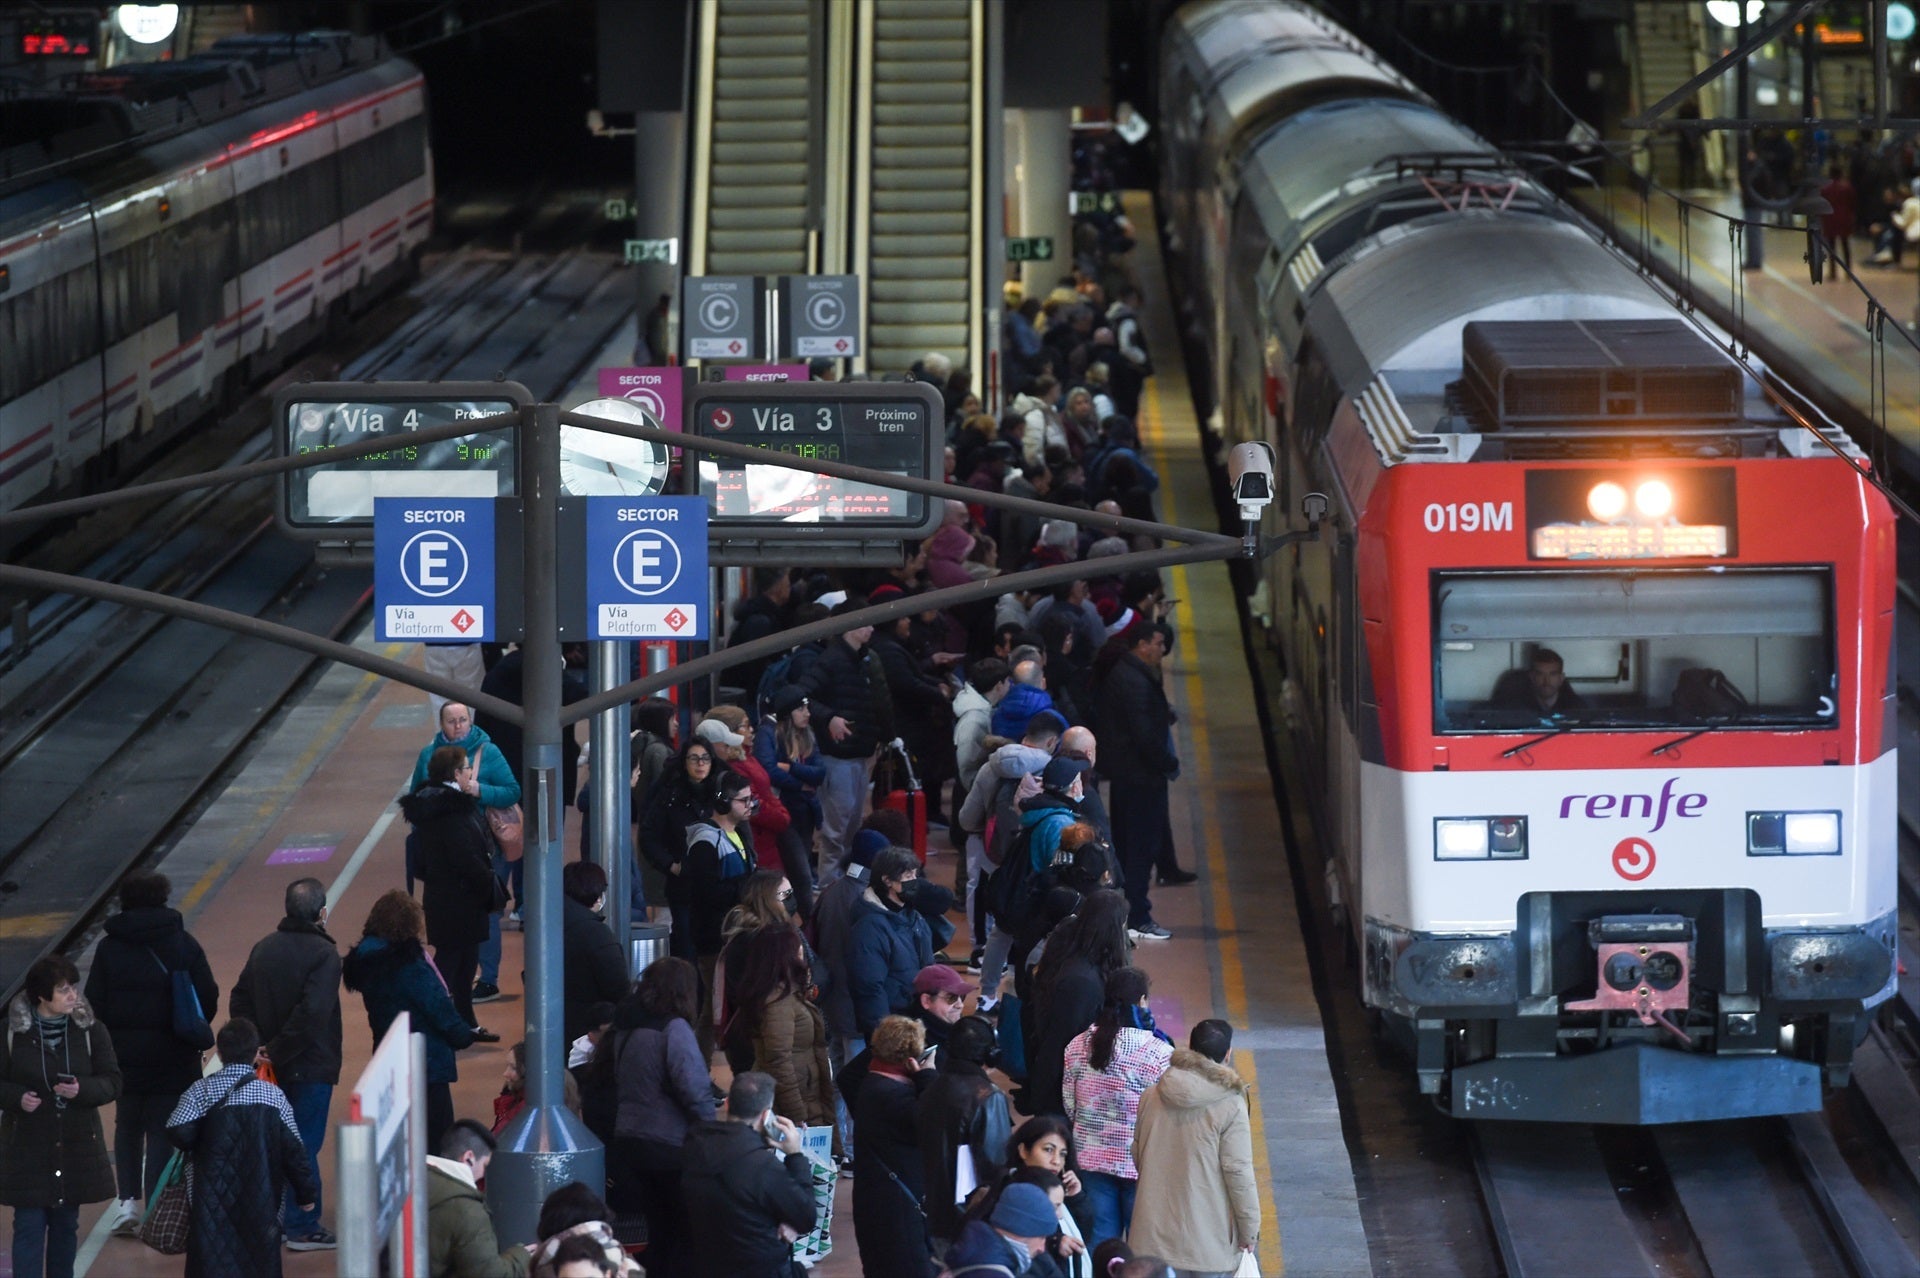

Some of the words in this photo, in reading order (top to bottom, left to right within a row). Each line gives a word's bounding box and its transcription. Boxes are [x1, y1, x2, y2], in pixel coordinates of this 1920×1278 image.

[707, 299, 730, 327] C
[813, 297, 836, 325] C
[619, 375, 661, 385] SECTOR
[343, 408, 384, 432] Vía
[402, 409, 419, 432] 4
[752, 407, 795, 431] Vía
[816, 408, 832, 431] 3
[866, 408, 917, 423] Próximo
[879, 422, 904, 432] tren
[457, 445, 469, 460] 9
[404, 510, 465, 523] SECTOR
[617, 508, 679, 521] SECTOR
[1424, 502, 1513, 532] 019M
[419, 541, 449, 586] E
[632, 540, 662, 585] E
[395, 608, 414, 620] Vía
[457, 612, 468, 629] 4
[608, 606, 627, 618] Vía
[670, 611, 681, 627] 3
[394, 621, 444, 636] Platform
[607, 620, 657, 635] Platform
[1559, 777, 1708, 833] renfe
